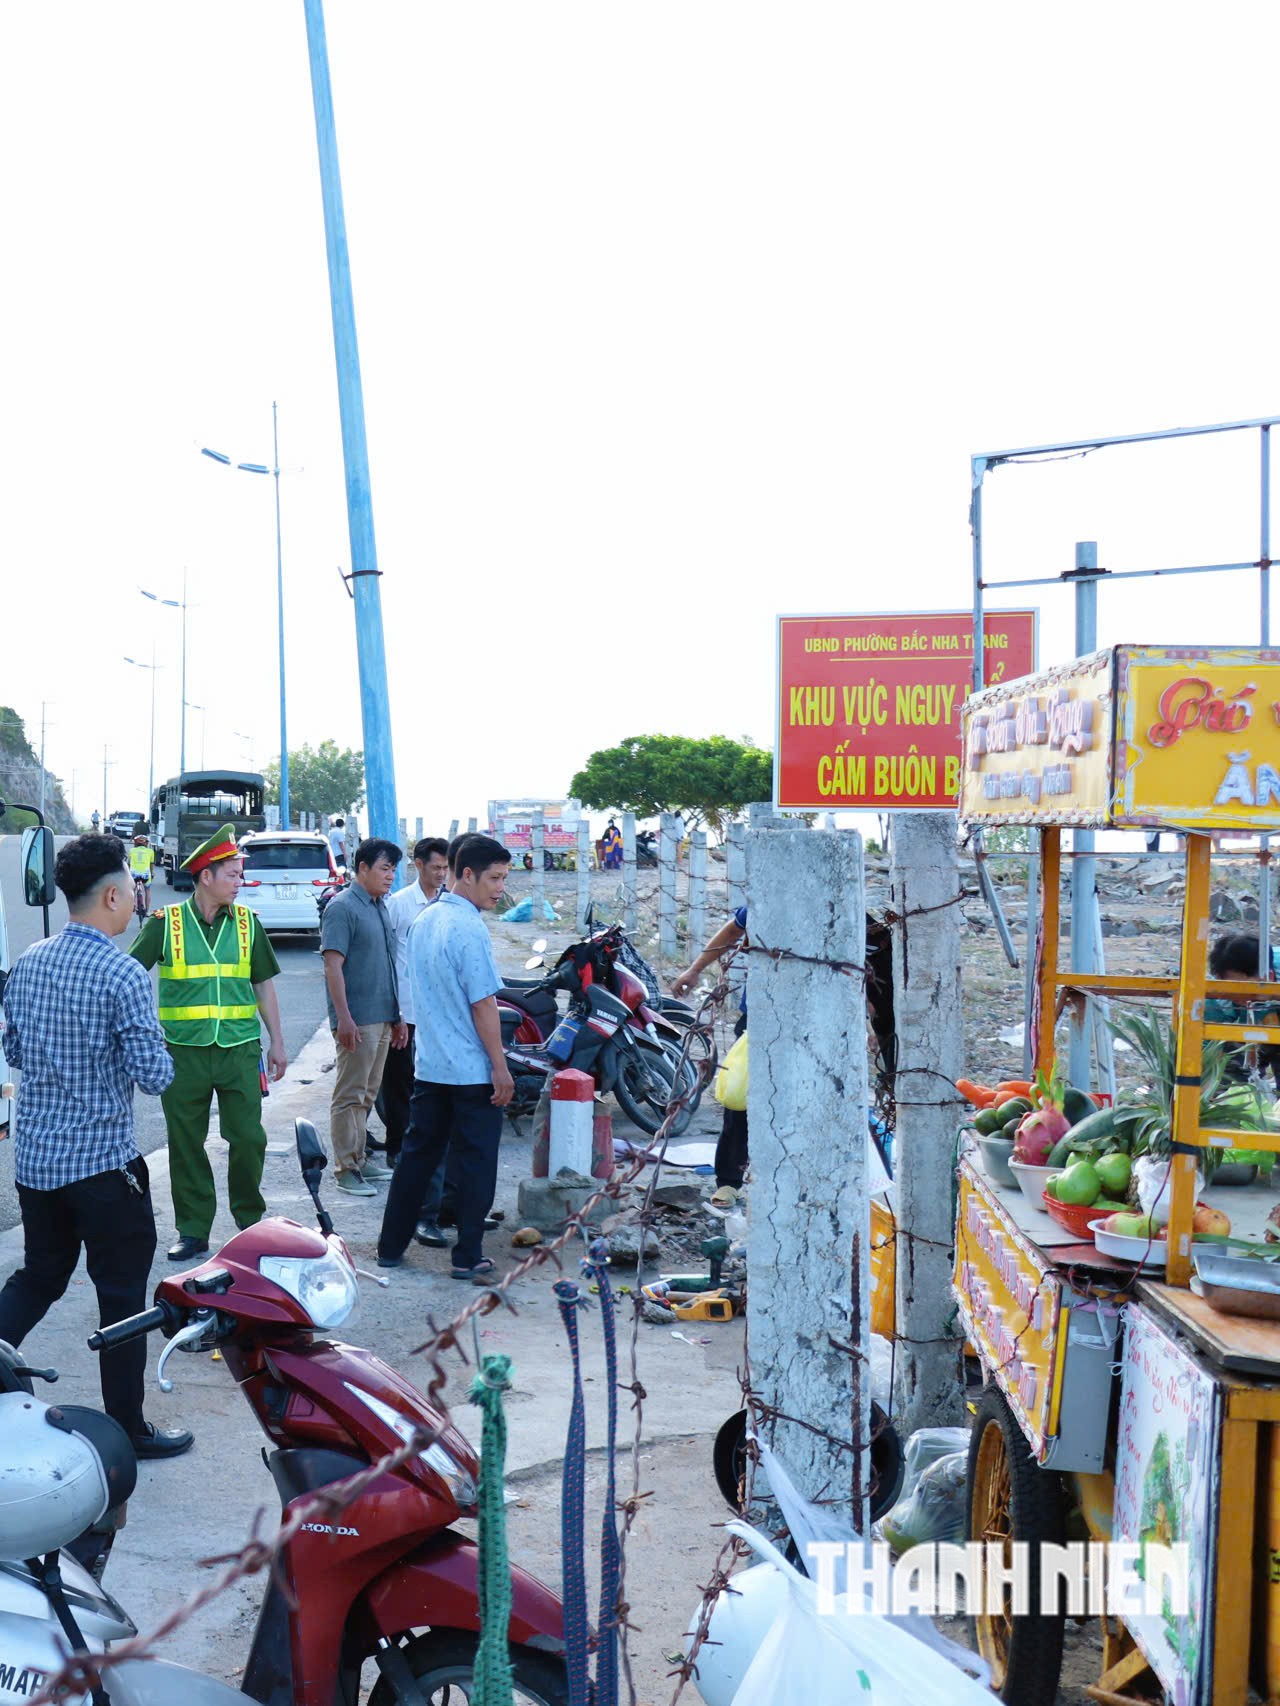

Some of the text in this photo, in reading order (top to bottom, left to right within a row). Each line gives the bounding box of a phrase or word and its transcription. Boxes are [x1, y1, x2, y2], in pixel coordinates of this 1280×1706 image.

[804, 630, 1009, 652] UBND PHƯỜNG BẮC NHA TANG
[789, 677, 956, 735] KHU VỰC NGUY
[817, 739, 866, 796] CẤM
[874, 744, 936, 796] BUÔN
[300, 1522, 360, 1536] HONDA
